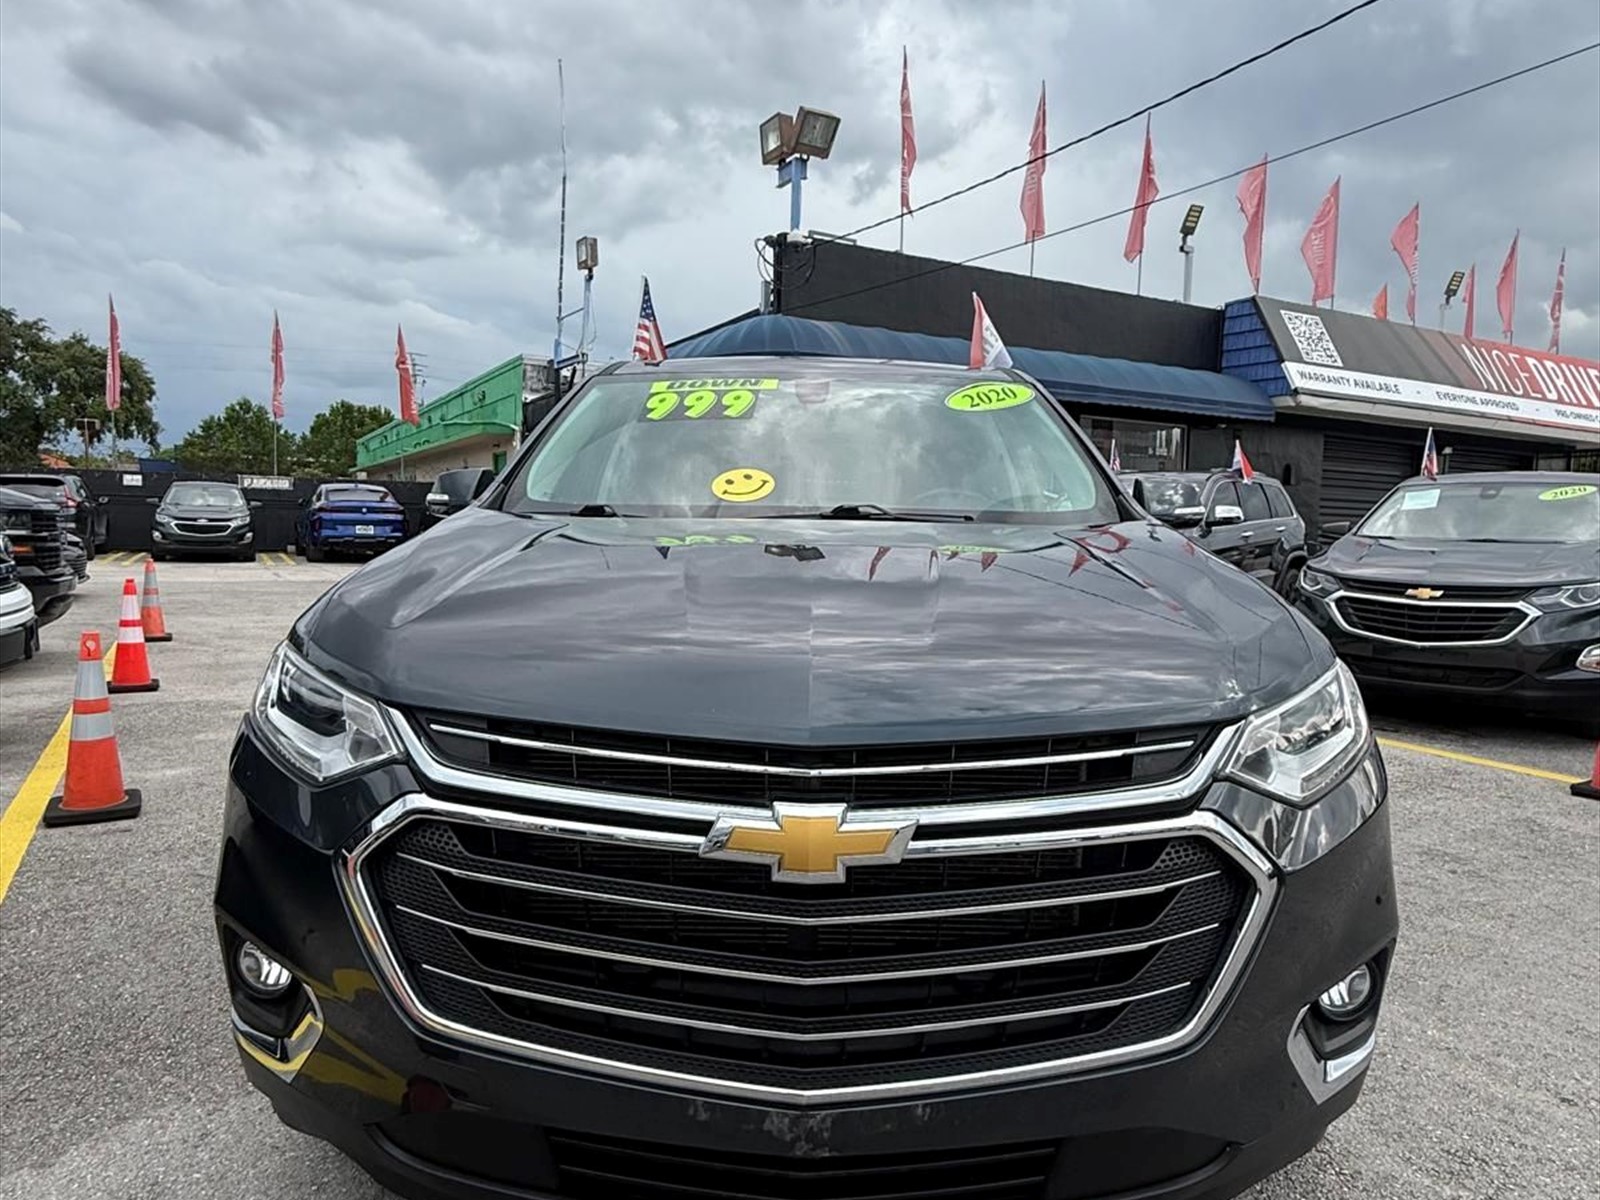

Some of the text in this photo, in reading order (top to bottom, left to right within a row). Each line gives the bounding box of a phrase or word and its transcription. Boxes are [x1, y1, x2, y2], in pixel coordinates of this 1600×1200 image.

[1297, 370, 1402, 395] WARRANTY AVAILABLE
[646, 390, 756, 420] 999
[962, 386, 1017, 408] 2020
[1436, 391, 1519, 411] EVERYONE APPROVED
[1551, 487, 1587, 499] 2020
